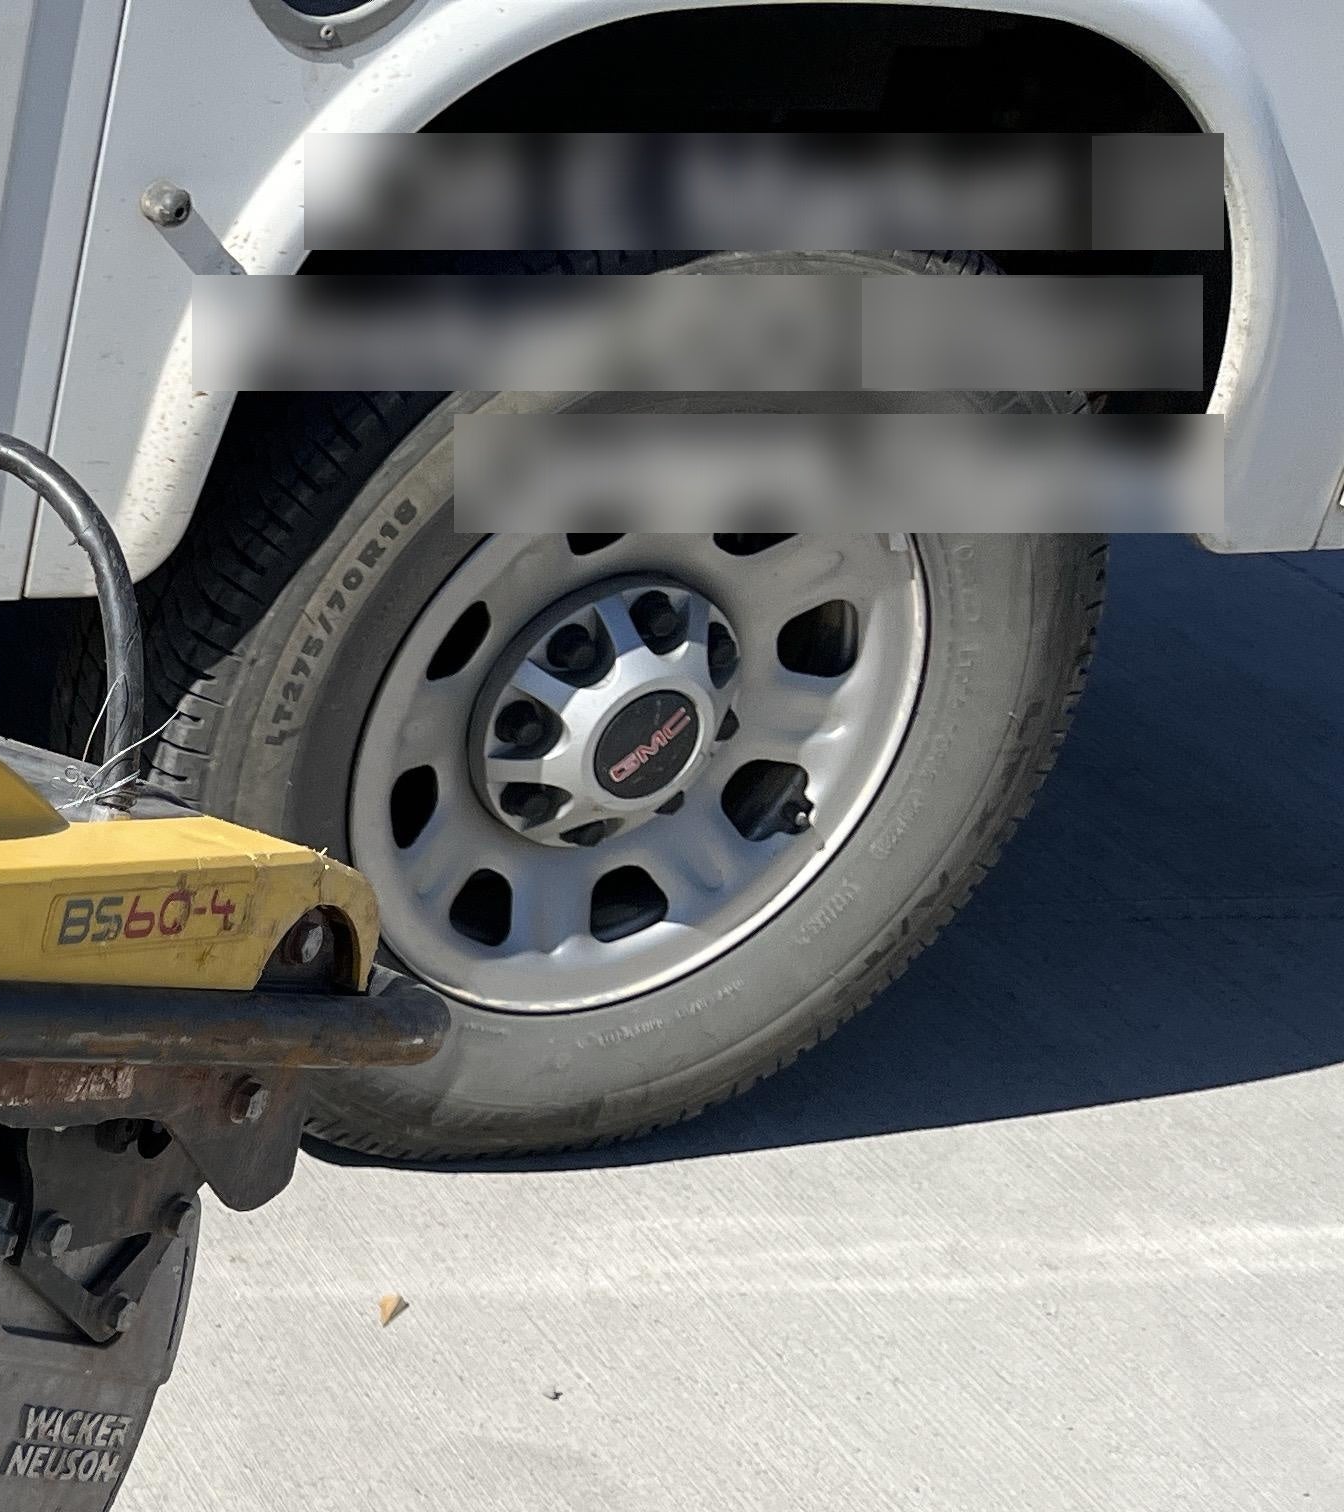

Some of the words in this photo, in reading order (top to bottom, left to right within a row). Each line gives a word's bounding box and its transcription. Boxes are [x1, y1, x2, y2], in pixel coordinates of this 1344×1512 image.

[264, 498, 418, 746] LT275/70R18
[609, 706, 691, 783] GMC
[20, 1404, 133, 1448] WACKER
[0, 1441, 123, 1483] NEUSON
